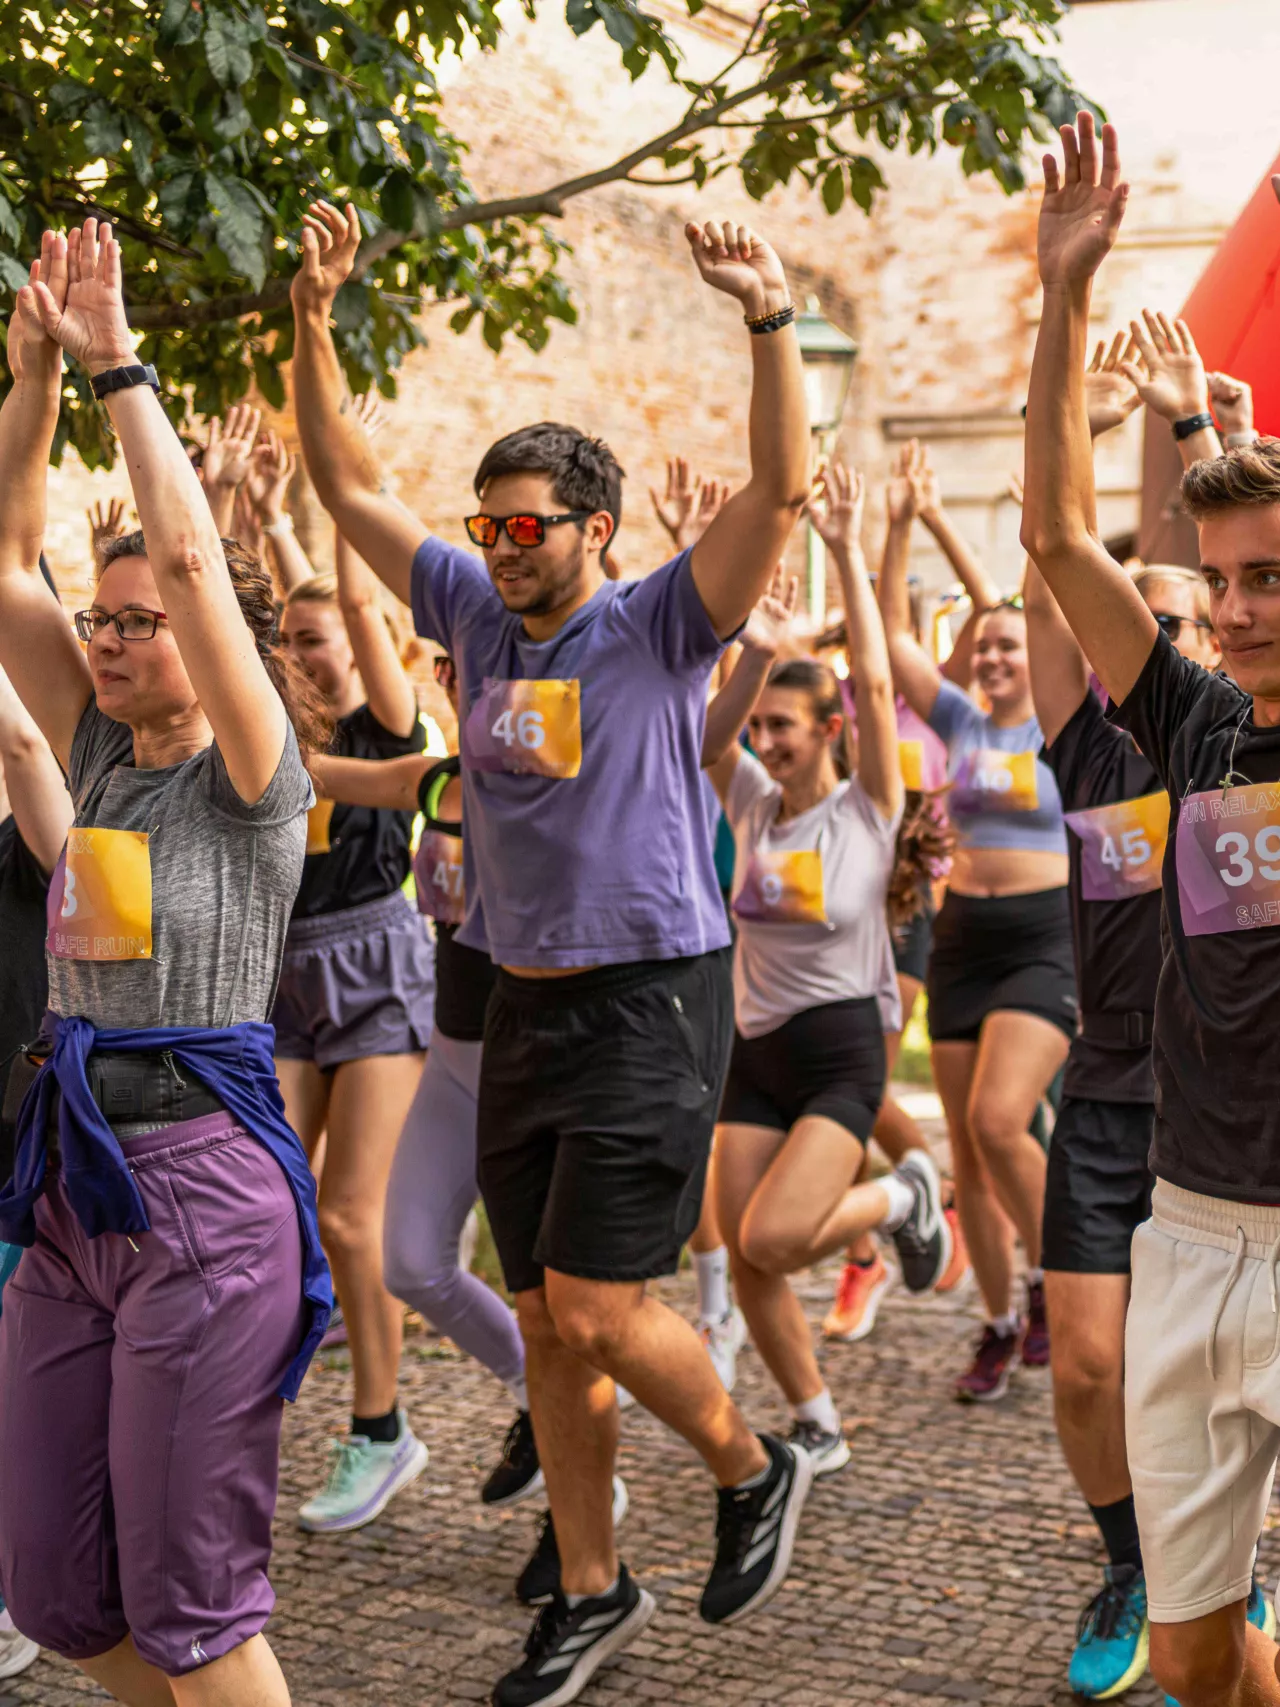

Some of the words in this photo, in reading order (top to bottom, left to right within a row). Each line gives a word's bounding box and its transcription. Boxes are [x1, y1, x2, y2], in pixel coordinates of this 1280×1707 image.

[491, 709, 546, 750] 46
[1180, 801, 1207, 825] FUN
[1101, 827, 1152, 872] 45
[432, 860, 464, 898] 47
[93, 936, 145, 956] RUN
